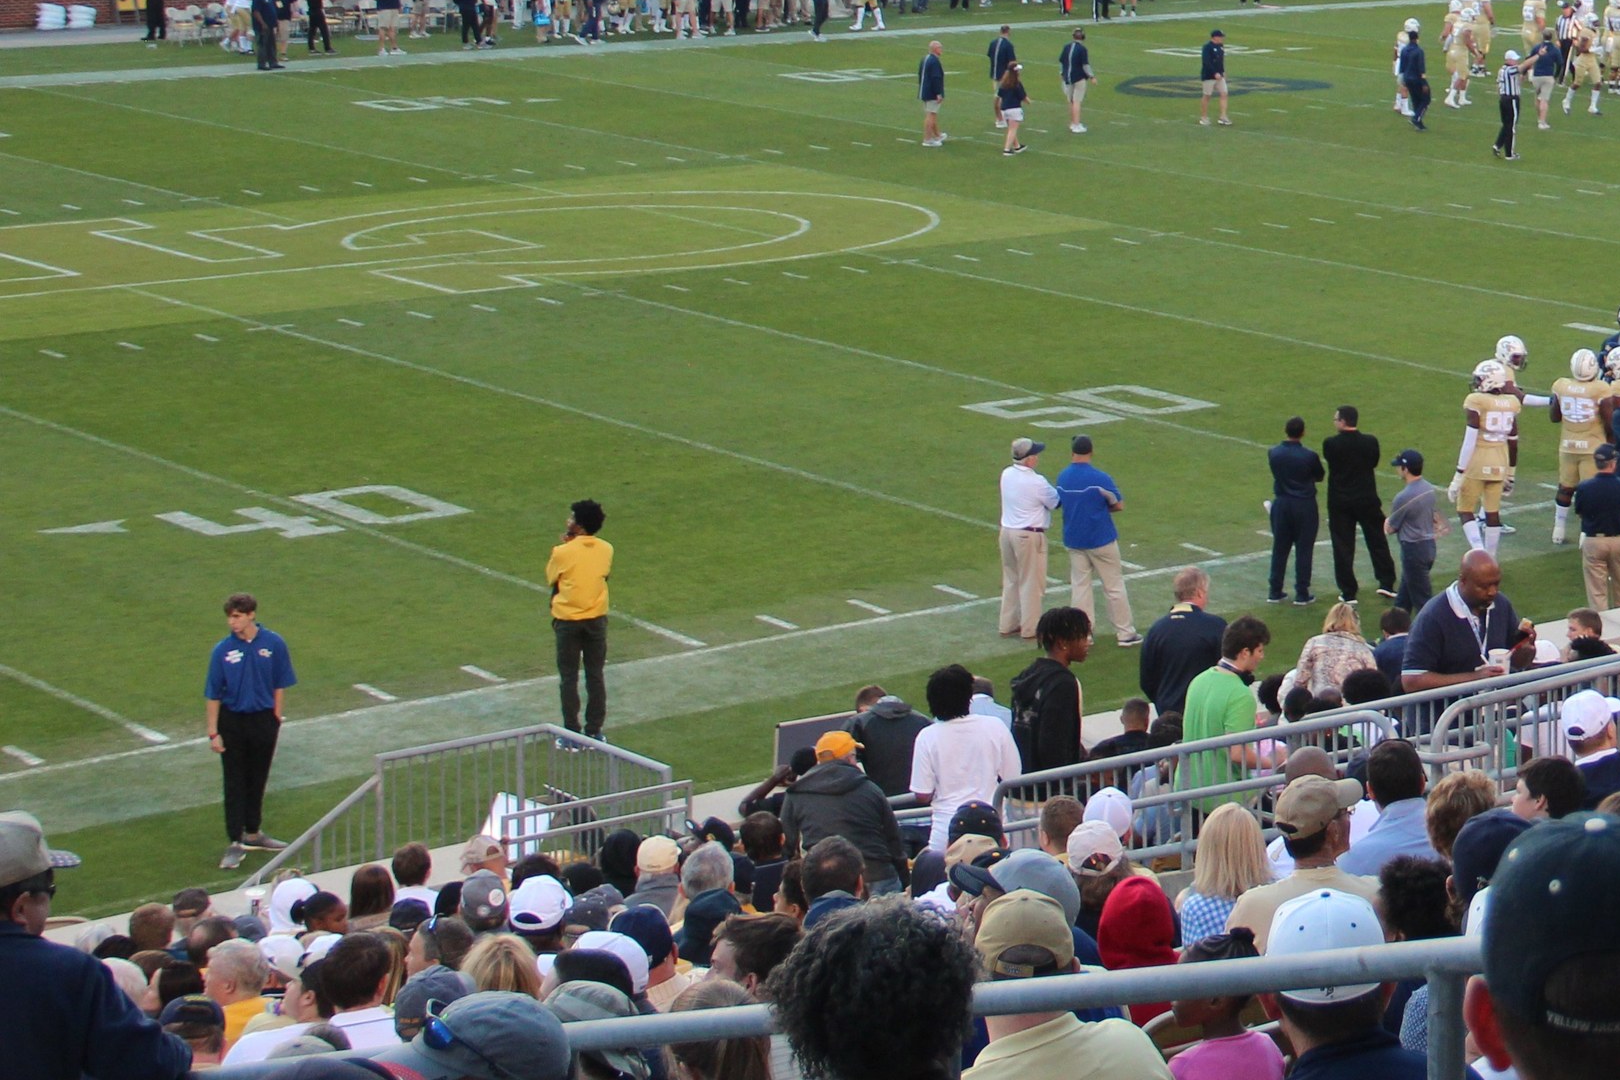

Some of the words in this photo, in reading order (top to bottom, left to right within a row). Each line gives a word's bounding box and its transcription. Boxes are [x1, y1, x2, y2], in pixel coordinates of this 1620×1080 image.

[959, 385, 1221, 428] 50
[154, 485, 474, 539] 40
[1546, 1011, 1591, 1032] YELLOW
